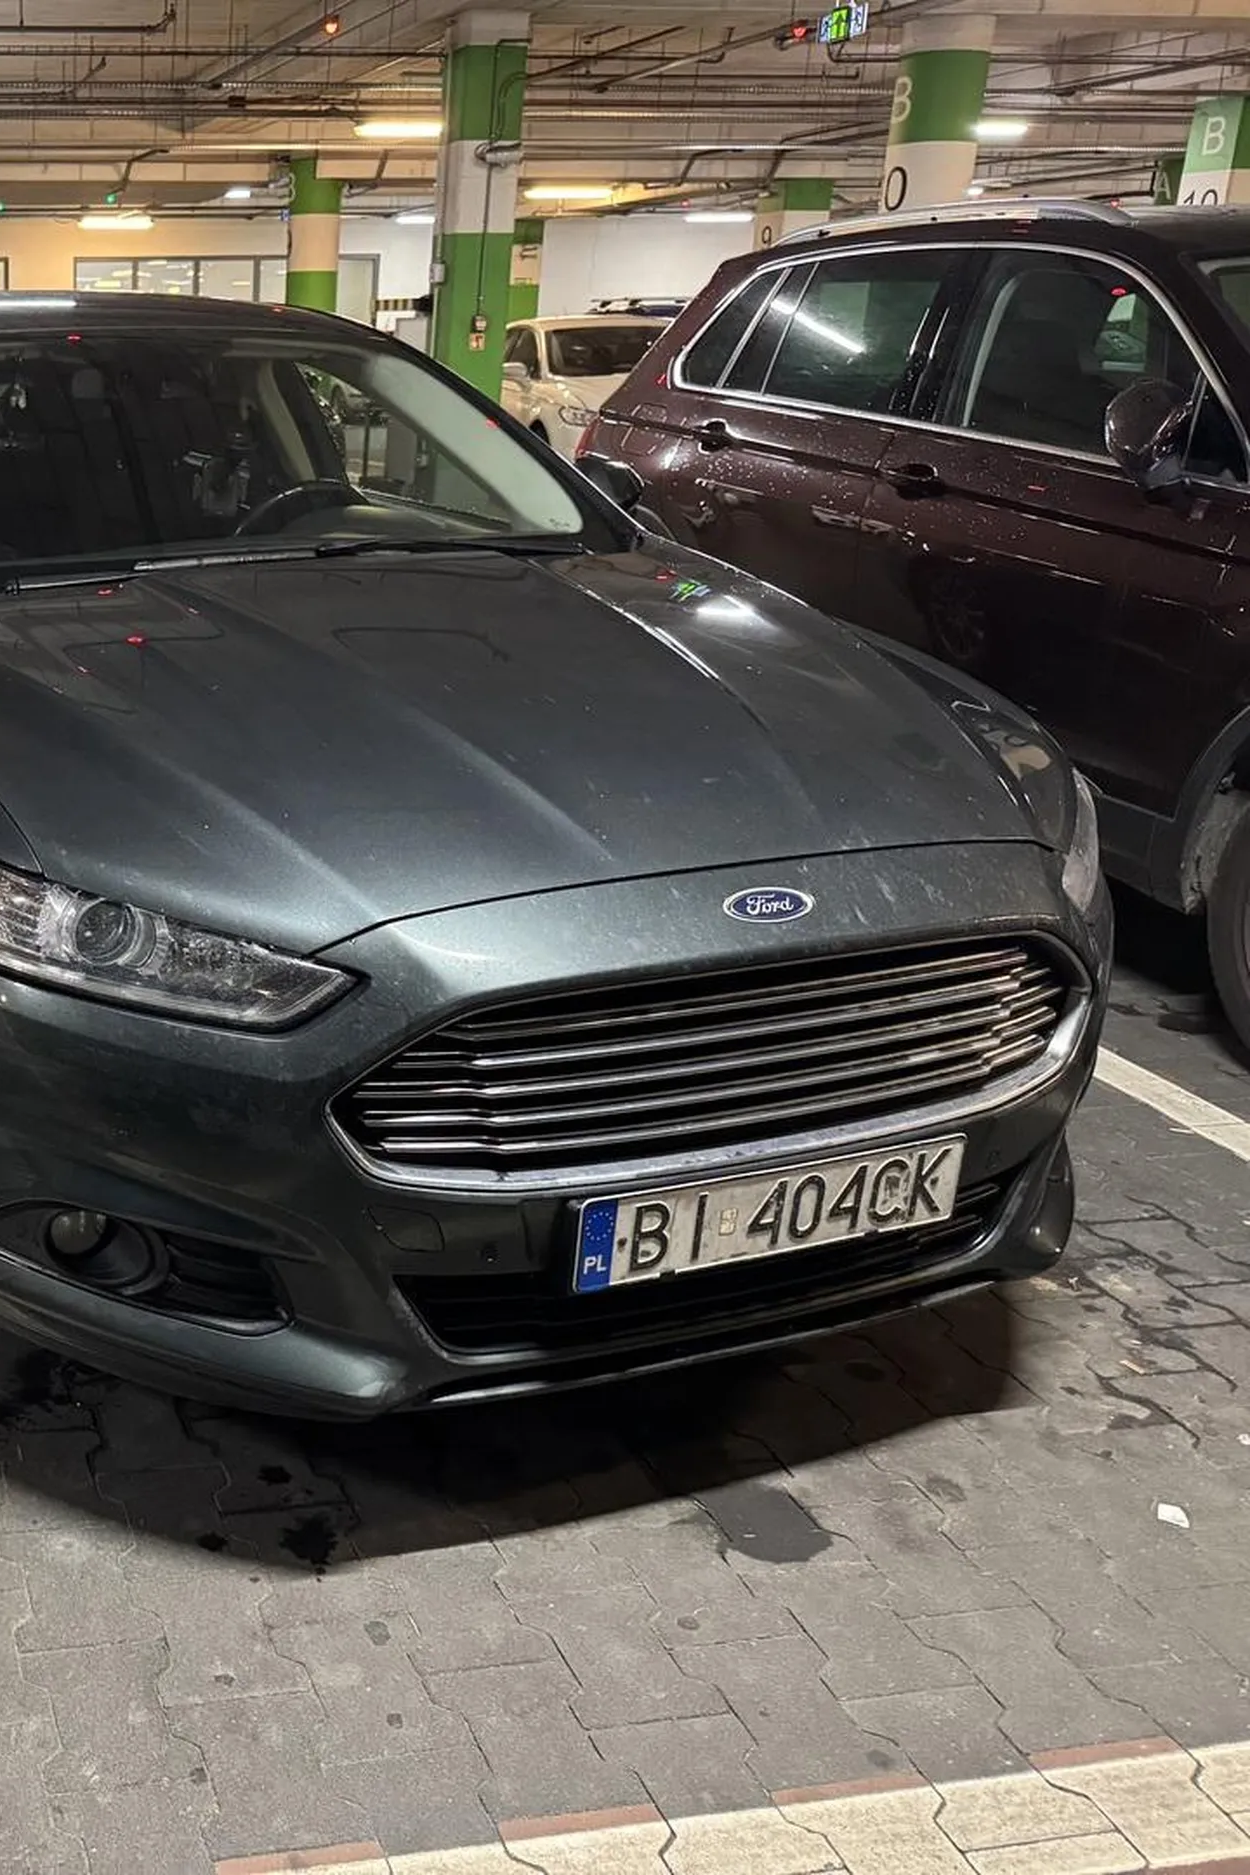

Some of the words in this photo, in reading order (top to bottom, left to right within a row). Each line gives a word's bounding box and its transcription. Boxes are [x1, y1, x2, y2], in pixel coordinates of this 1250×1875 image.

[891, 76, 913, 124] B
[1201, 116, 1226, 156] B
[746, 893, 795, 915] Ford
[629, 1191, 709, 1272] BI
[747, 1147, 953, 1247] 404CK
[583, 1254, 607, 1275] PL
